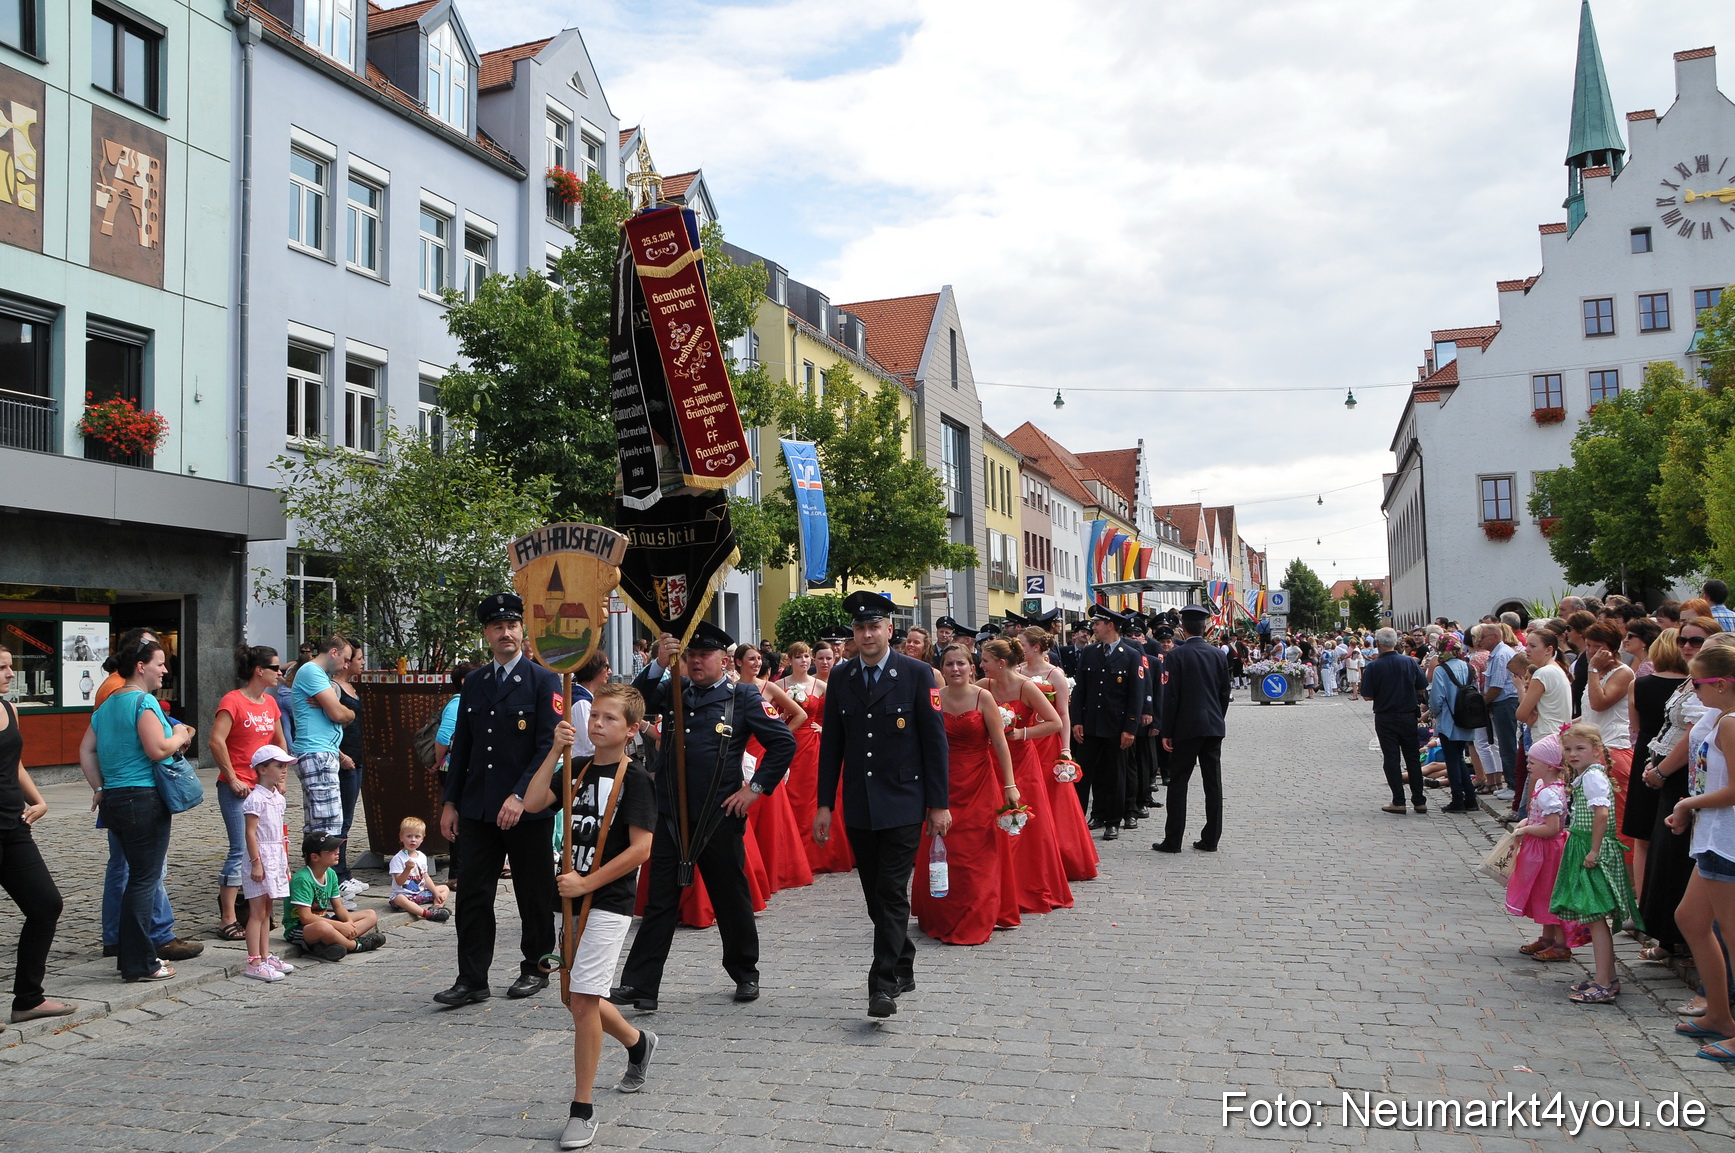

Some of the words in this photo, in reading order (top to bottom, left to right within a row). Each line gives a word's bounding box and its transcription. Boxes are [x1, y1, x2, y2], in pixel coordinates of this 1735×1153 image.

[641, 230, 676, 246] 25.5.2014
[652, 283, 696, 304] Gewidmet
[660, 304, 679, 315] von
[680, 299, 696, 310] den
[692, 382, 708, 394] zum
[682, 397, 695, 409] 125
[694, 390, 724, 407] jährigen
[685, 403, 730, 420] Gründungs-
[707, 429, 719, 443] FF
[620, 445, 652, 460] Hausheim
[695, 440, 740, 460] Hausheim
[514, 526, 616, 564] FFW-HAUSHEIM
